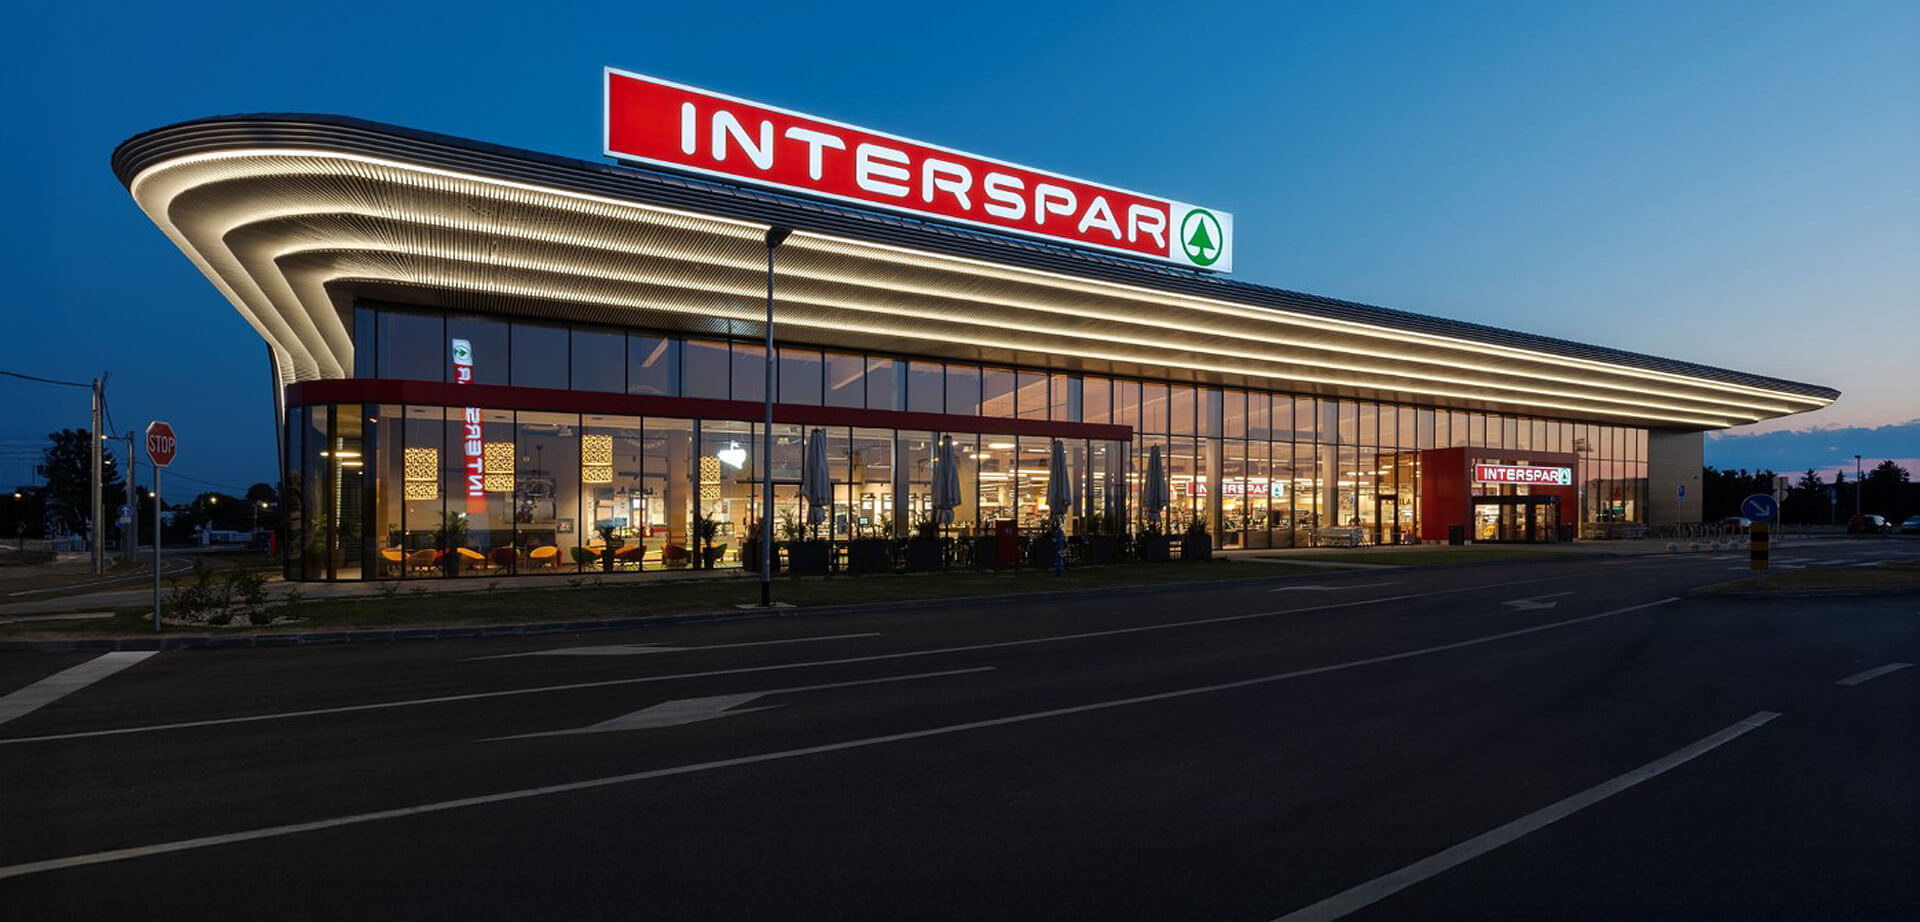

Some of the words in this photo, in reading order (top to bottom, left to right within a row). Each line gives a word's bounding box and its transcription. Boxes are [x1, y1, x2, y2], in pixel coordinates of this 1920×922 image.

[681, 102, 1167, 249] INTERSPAR
[149, 434, 175, 454] STOP
[1484, 467, 1559, 482] INTERSPAR
